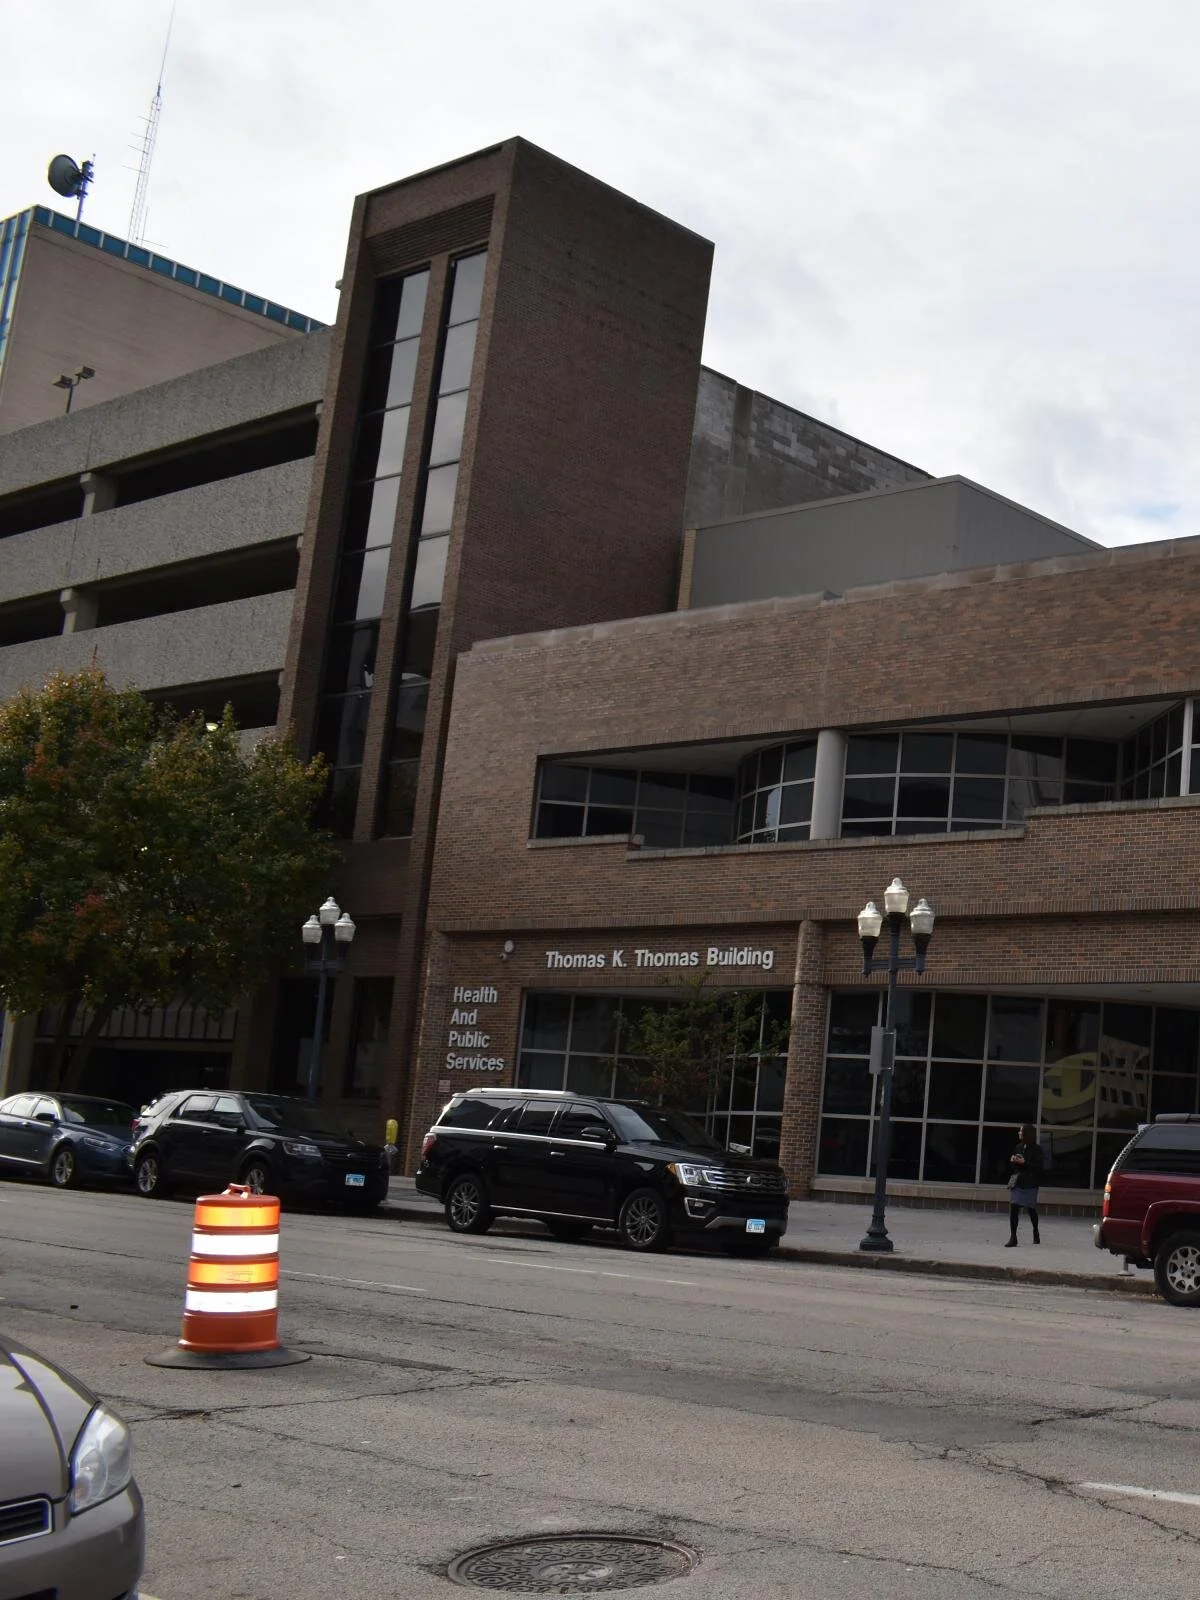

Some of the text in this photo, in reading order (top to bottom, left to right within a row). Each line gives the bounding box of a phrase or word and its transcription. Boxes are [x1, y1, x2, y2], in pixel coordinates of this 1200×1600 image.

[545, 946, 775, 970] Thomas K. Thomas Building
[453, 986, 498, 1004] Health
[450, 1008, 477, 1026] And
[448, 1030, 490, 1049] Public
[445, 1053, 505, 1072] Services
